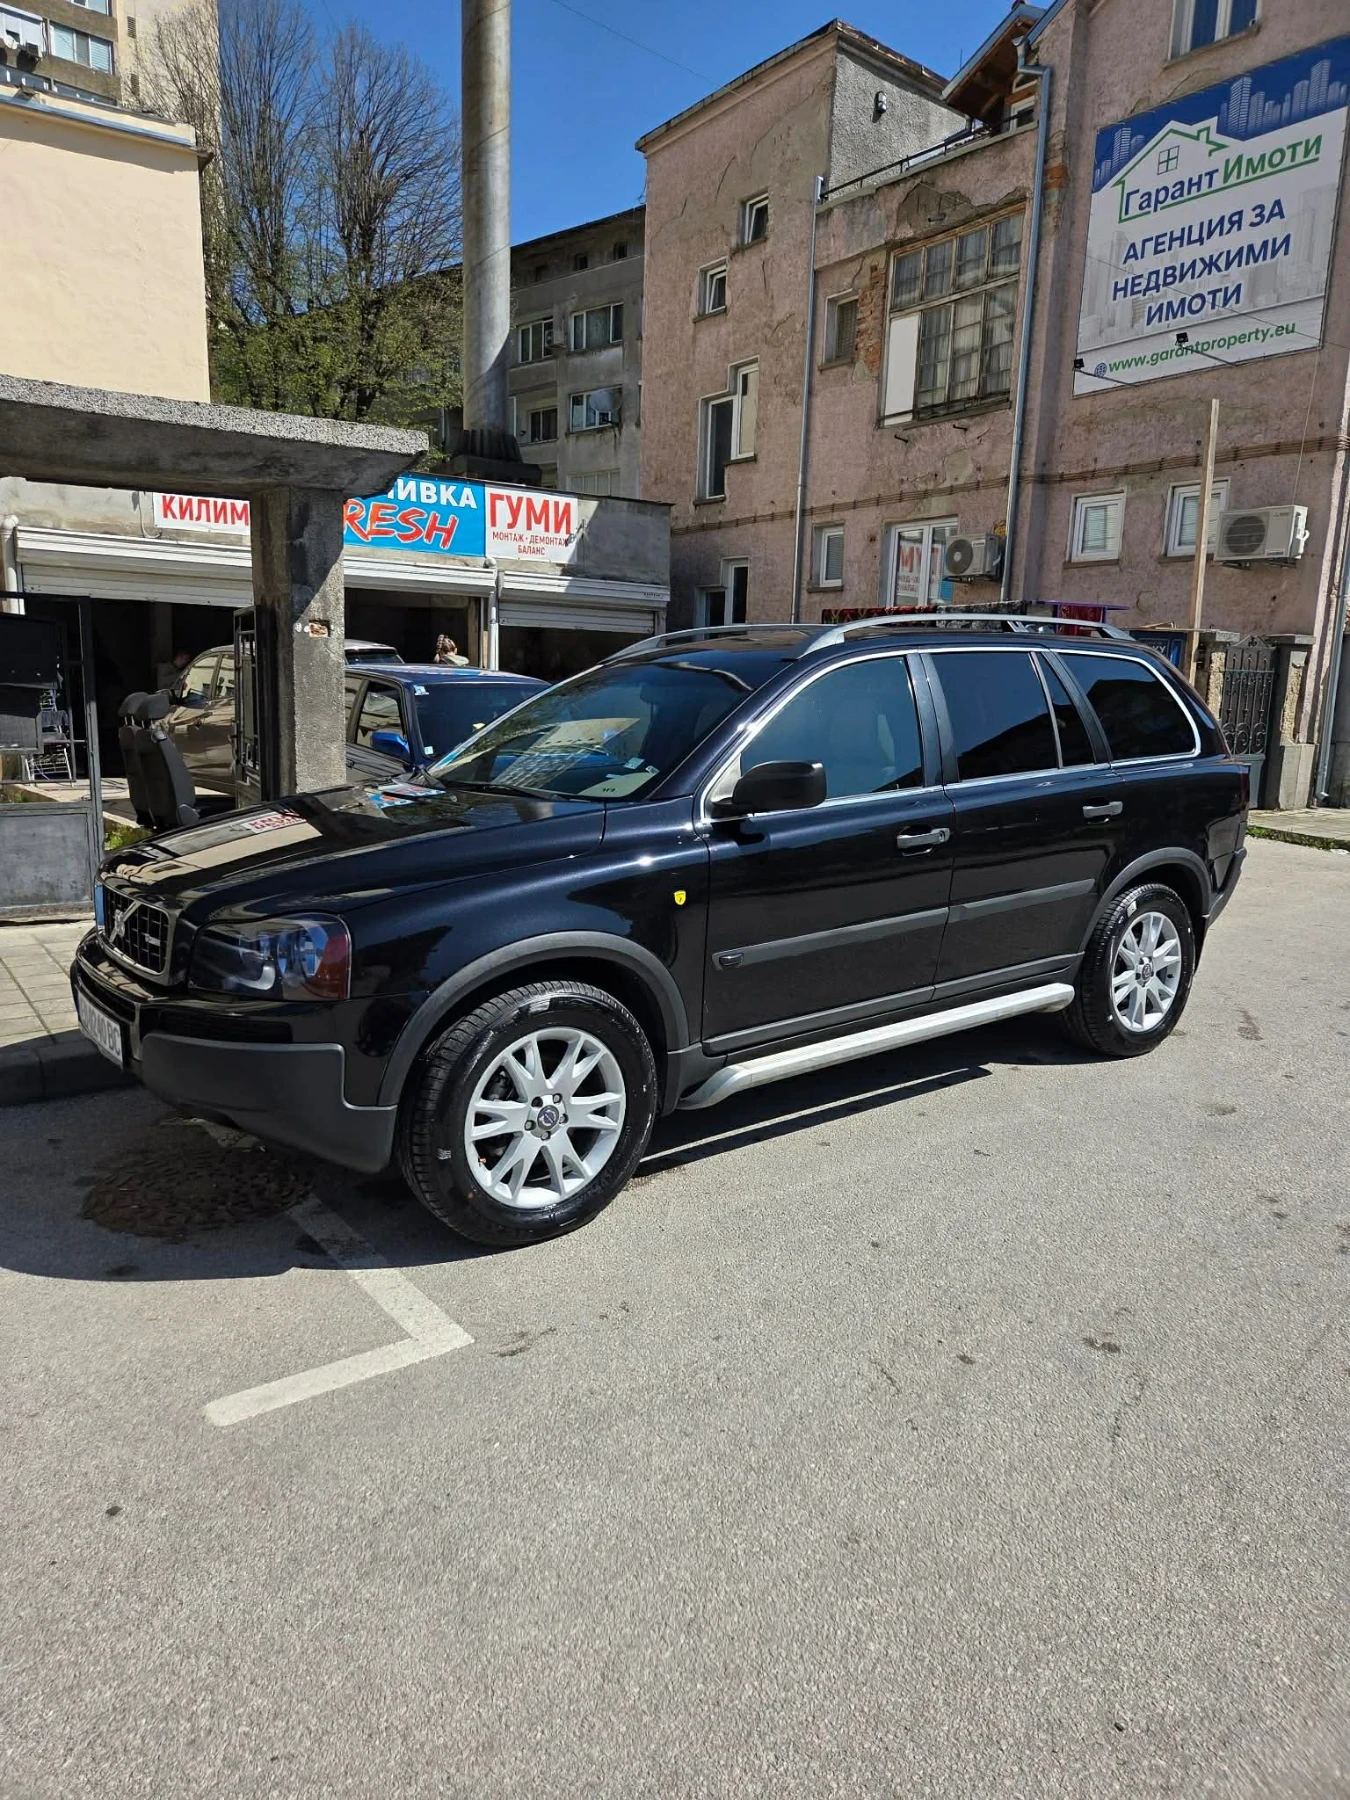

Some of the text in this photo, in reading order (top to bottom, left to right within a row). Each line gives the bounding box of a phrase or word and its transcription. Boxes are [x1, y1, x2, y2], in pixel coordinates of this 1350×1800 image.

[1124, 134, 1323, 216] Гарант Имоти
[1122, 198, 1286, 265] АГЕНЦИЯ ЗА
[1112, 233, 1292, 301] НЕДВИЖИМИ
[1146, 283, 1243, 327] ИМОТИ
[1108, 322, 1296, 373] www.garantproperty.eu
[489, 492, 571, 535] ГУМИ
[492, 531, 524, 543] МОНТАЖ
[517, 545, 546, 556] БАЛАНС
